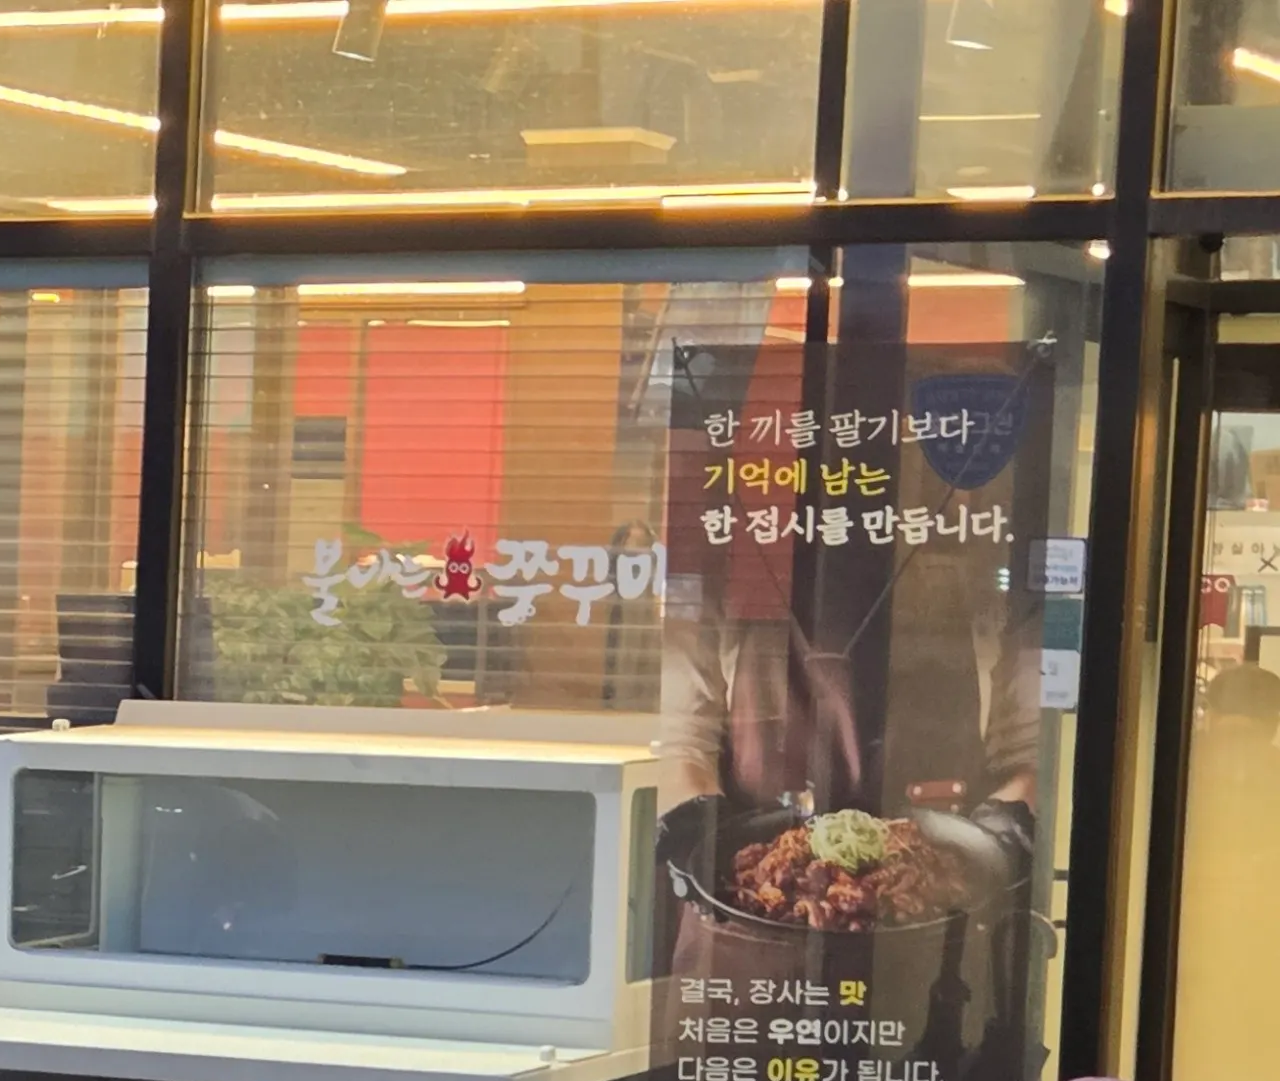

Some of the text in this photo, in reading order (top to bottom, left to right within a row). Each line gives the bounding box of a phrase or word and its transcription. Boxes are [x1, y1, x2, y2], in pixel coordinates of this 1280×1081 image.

[704, 410, 741, 448] 한
[749, 410, 820, 448] 끼를
[829, 407, 974, 448] 팔기보다
[704, 459, 890, 496] 기억에 남는
[700, 505, 1014, 546] 한 접시를 만듭니다.
[679, 978, 866, 1007] 결국, 장사는 맛
[678, 1018, 903, 1046] 처음은 우연이지만
